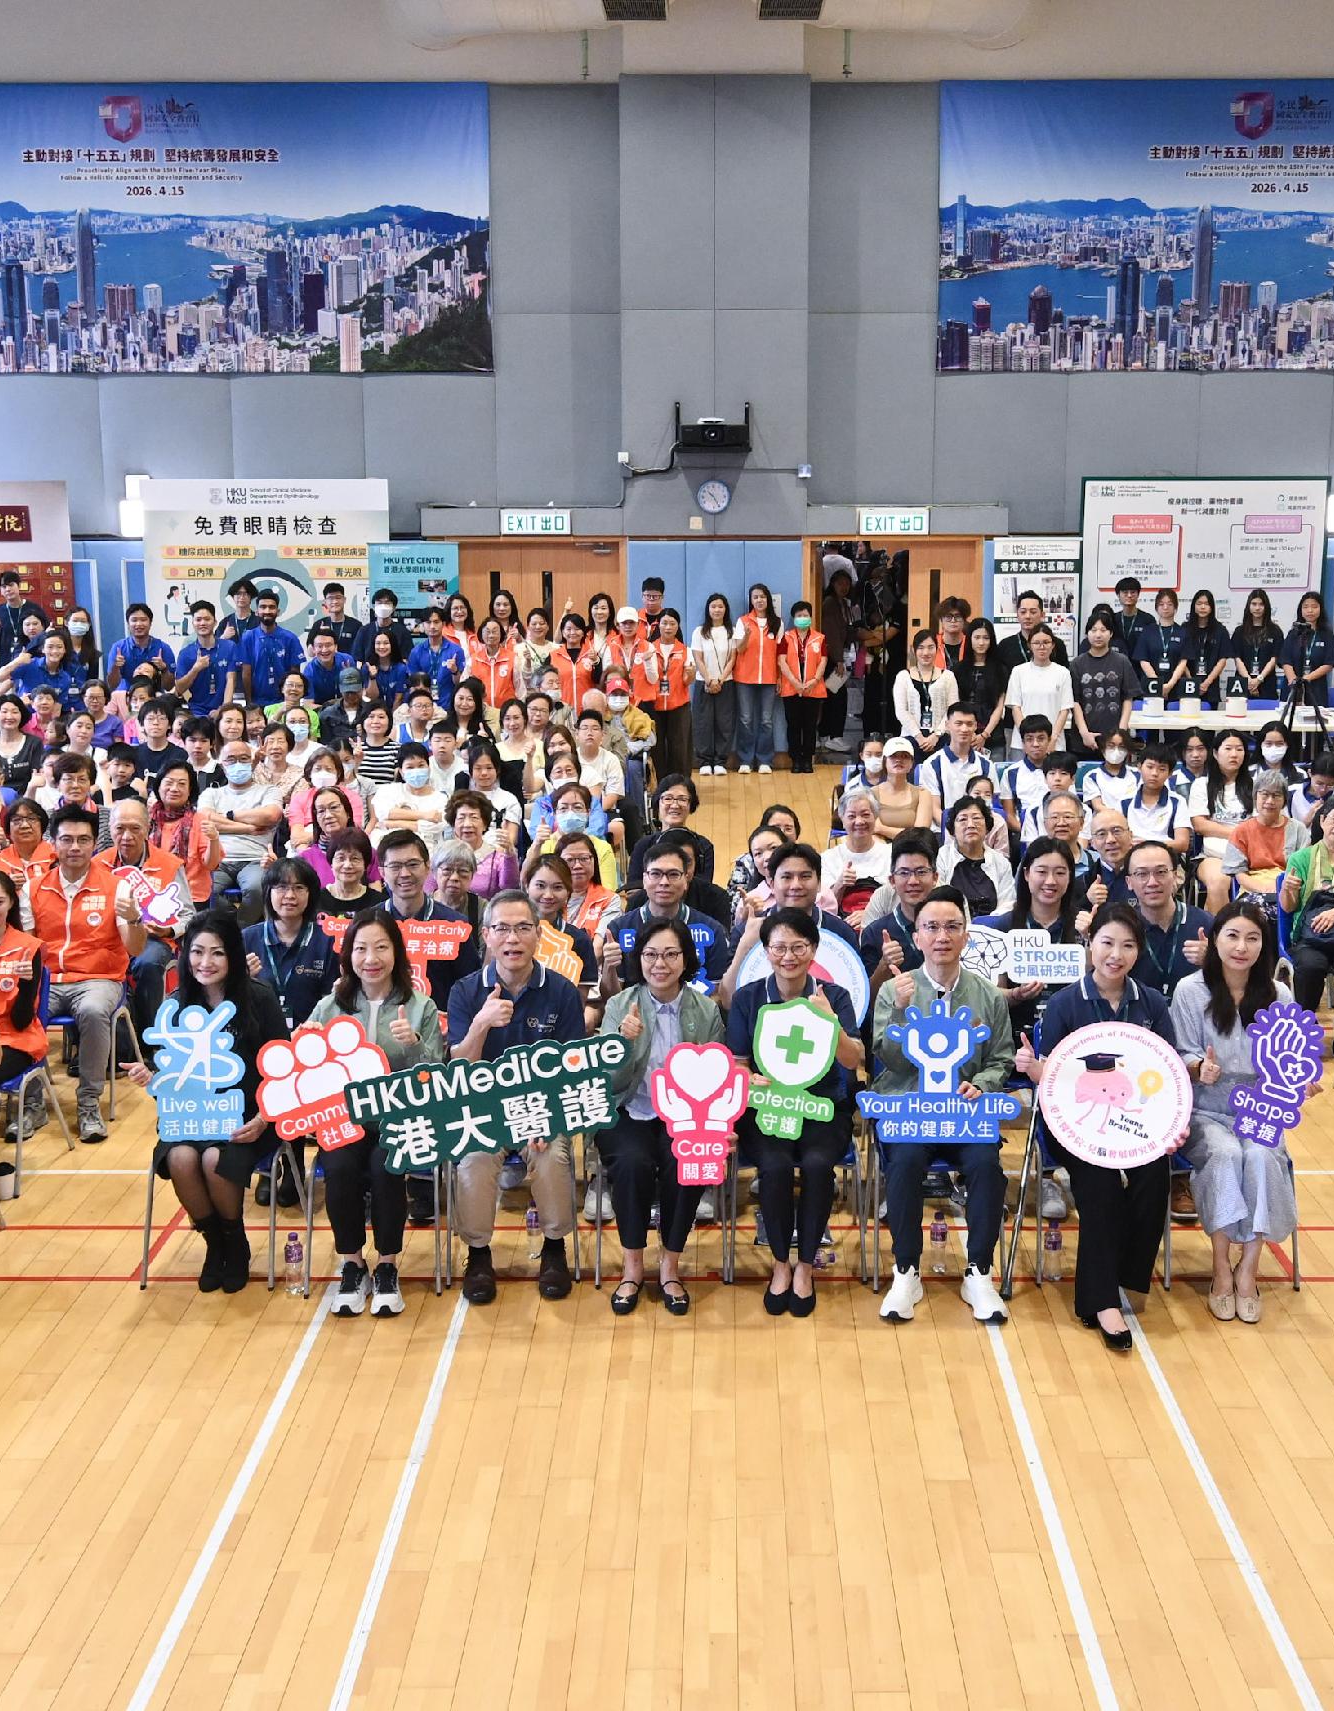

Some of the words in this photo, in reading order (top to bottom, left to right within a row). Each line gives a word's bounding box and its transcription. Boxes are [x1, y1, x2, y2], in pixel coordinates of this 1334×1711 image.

[23, 149, 155, 163] 主動對接「十五五」規劃
[165, 149, 279, 163] 堅持統籌發展和安全
[1149, 146, 1283, 160] 主動對接「十五五」規劃
[226, 488, 247, 497] HKU
[226, 497, 247, 505] Med
[194, 515, 338, 536] 免費眼睛檢查
[506, 515, 537, 533] EXIT
[540, 515, 565, 533] 出口
[865, 515, 896, 533] EXIT
[899, 515, 924, 533] 出口
[335, 567, 362, 578] 青光眼
[1000, 561, 1075, 572] 香港大學社區藥房
[1147, 680, 1158, 694] C
[1184, 681, 1196, 695] B
[1231, 680, 1244, 694] A
[408, 922, 437, 935] Treat
[438, 924, 467, 939] Early
[406, 939, 455, 956] 早治療
[1013, 936, 1044, 948] HKU
[1013, 950, 1080, 963] STROKE
[1013, 964, 1080, 978] 中風研究組
[350, 1038, 626, 1119] HKUMediCare
[162, 1097, 197, 1113] Live
[203, 1095, 239, 1112] well
[749, 1088, 830, 1117] rotection
[861, 1097, 902, 1114] Your
[908, 1096, 979, 1118] Healthy
[984, 1097, 1016, 1114] Life
[1234, 1090, 1296, 1125] Shape
[164, 1118, 239, 1137] 活出健康
[281, 1103, 348, 1136] Commu
[385, 1077, 613, 1169] 港大醫護
[762, 1112, 798, 1135] 守護
[881, 1119, 995, 1138] 你的健康人生
[1120, 1113, 1144, 1130] Young
[322, 1123, 359, 1146] 社區
[1108, 1118, 1131, 1133] Brain
[1133, 1128, 1149, 1140] Lab
[1239, 1116, 1279, 1143] 掌握
[677, 1139, 724, 1157] Care
[682, 1163, 719, 1181] 關愛
